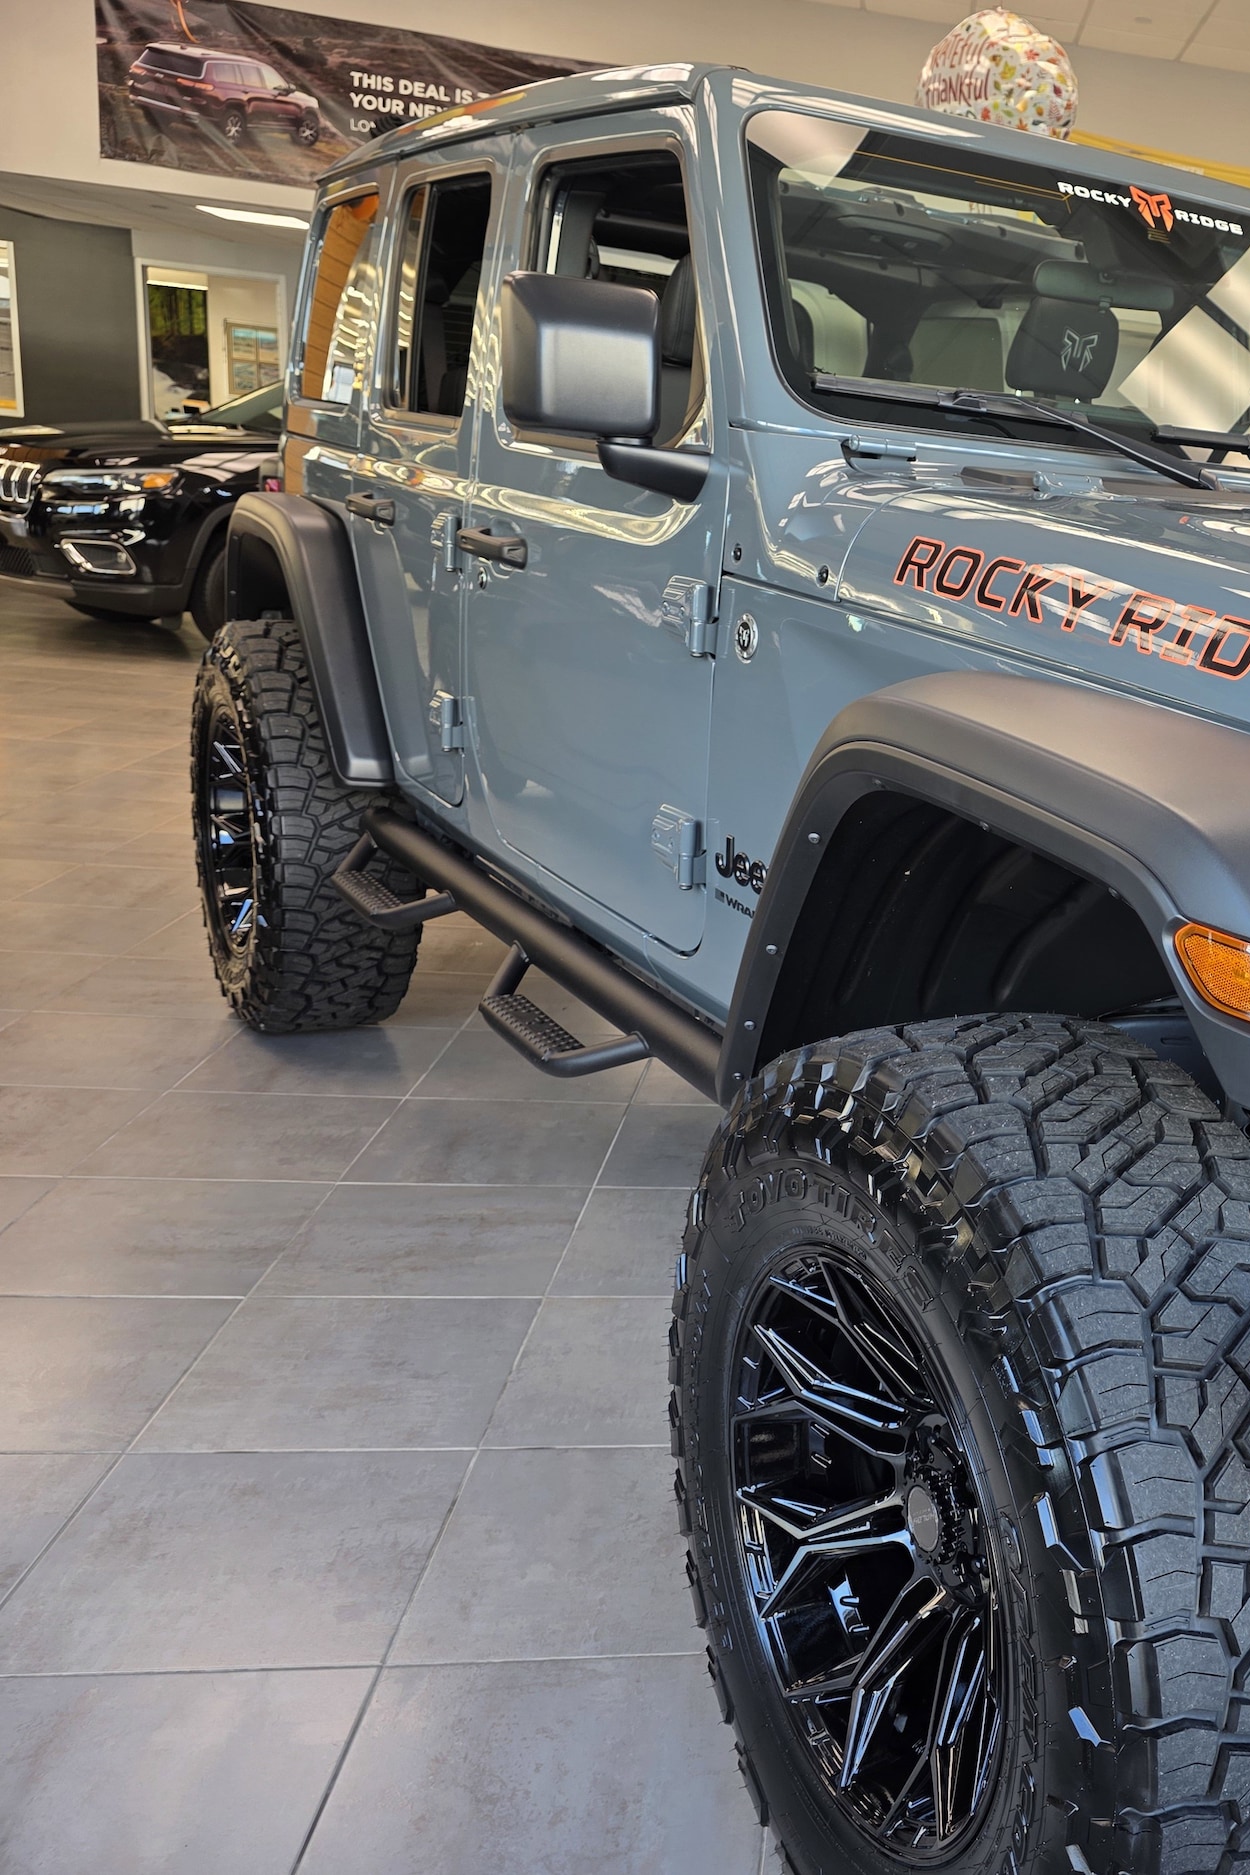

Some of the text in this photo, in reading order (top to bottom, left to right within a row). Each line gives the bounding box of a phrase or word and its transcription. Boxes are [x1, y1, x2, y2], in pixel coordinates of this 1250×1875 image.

[350, 71, 394, 92] THIS
[398, 79, 450, 102] DEAL
[455, 88, 474, 104] IS
[350, 92, 404, 116] YOUR
[1057, 181, 1243, 236] ROCKY RIDGE
[894, 536, 1113, 632] ROCKY
[715, 833, 768, 895] Jee
[724, 1168, 809, 1233] TOYO
